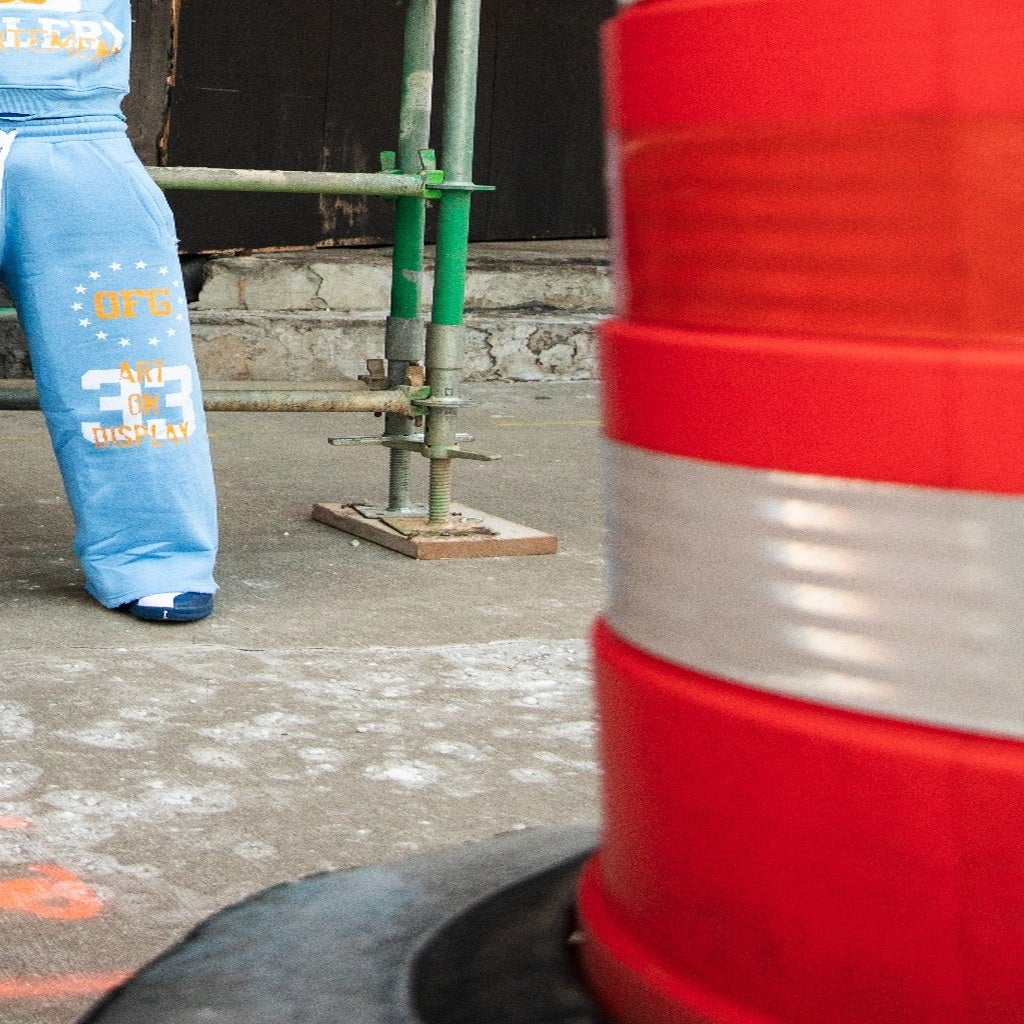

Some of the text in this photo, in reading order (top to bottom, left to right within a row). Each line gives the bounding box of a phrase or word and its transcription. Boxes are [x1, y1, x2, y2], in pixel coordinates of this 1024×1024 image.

[93, 288, 172, 320] OFG
[119, 360, 166, 384] ART
[81, 364, 196, 443] 33
[128, 392, 161, 416] ON
[91, 422, 190, 449] DISPLAY
